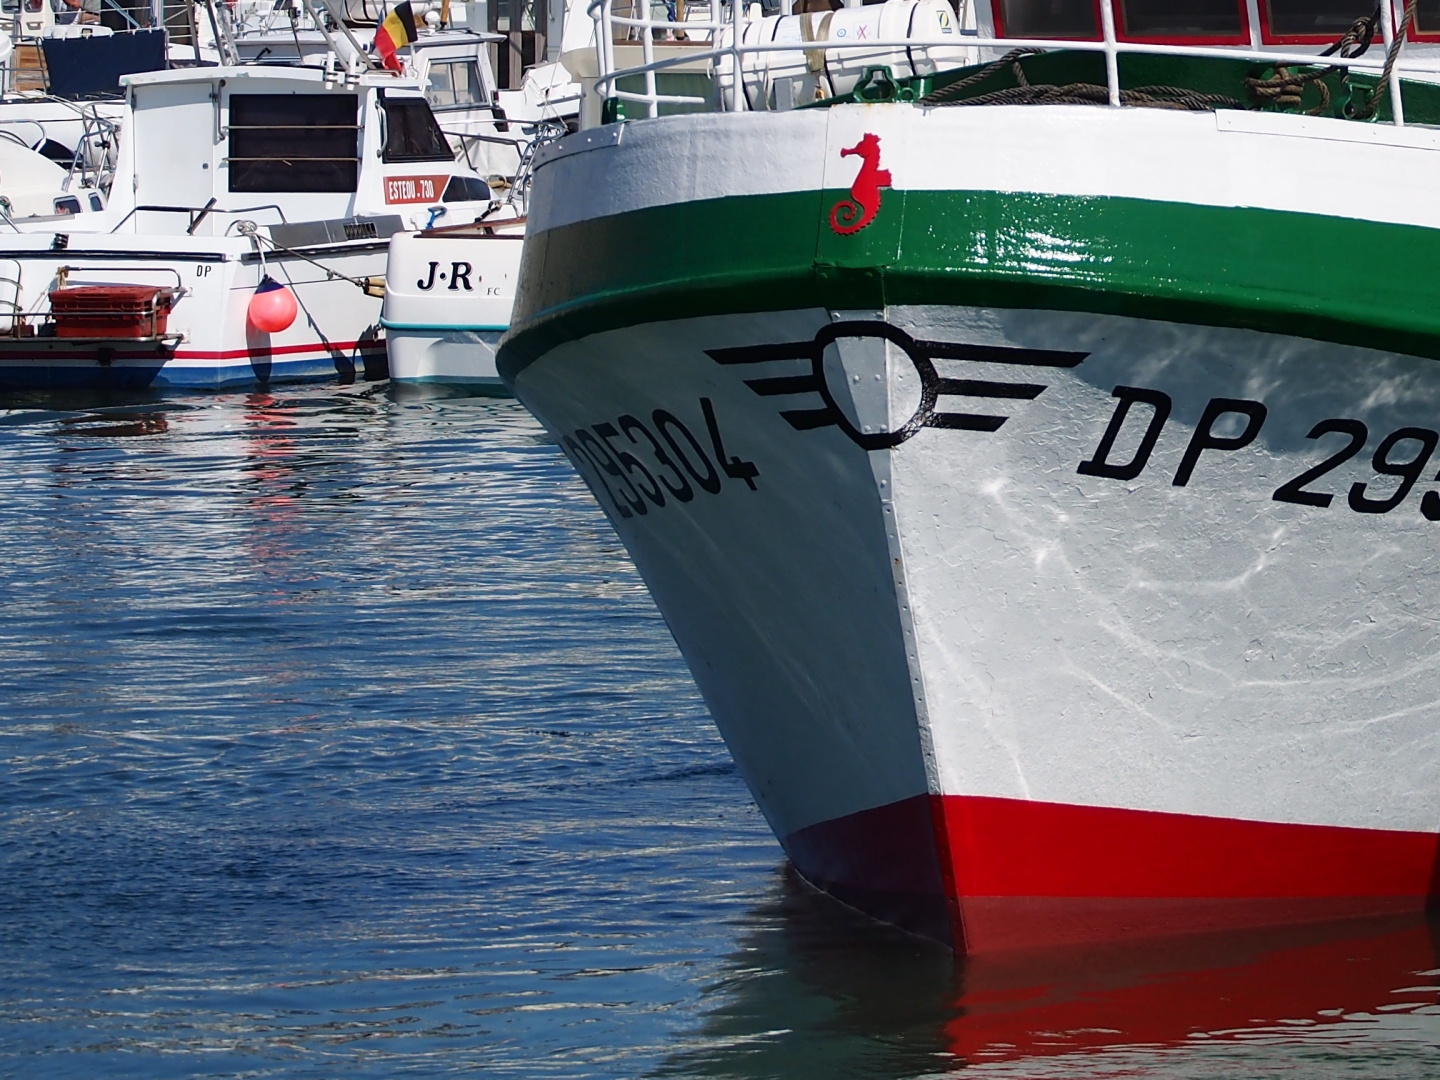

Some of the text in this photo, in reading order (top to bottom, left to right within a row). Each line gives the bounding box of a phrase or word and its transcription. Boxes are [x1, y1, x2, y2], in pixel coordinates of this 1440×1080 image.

[388, 180, 416, 200] ESTEOU
[196, 264, 212, 278] DP
[562, 397, 760, 519] 295304
[1076, 385, 1268, 487] DP
